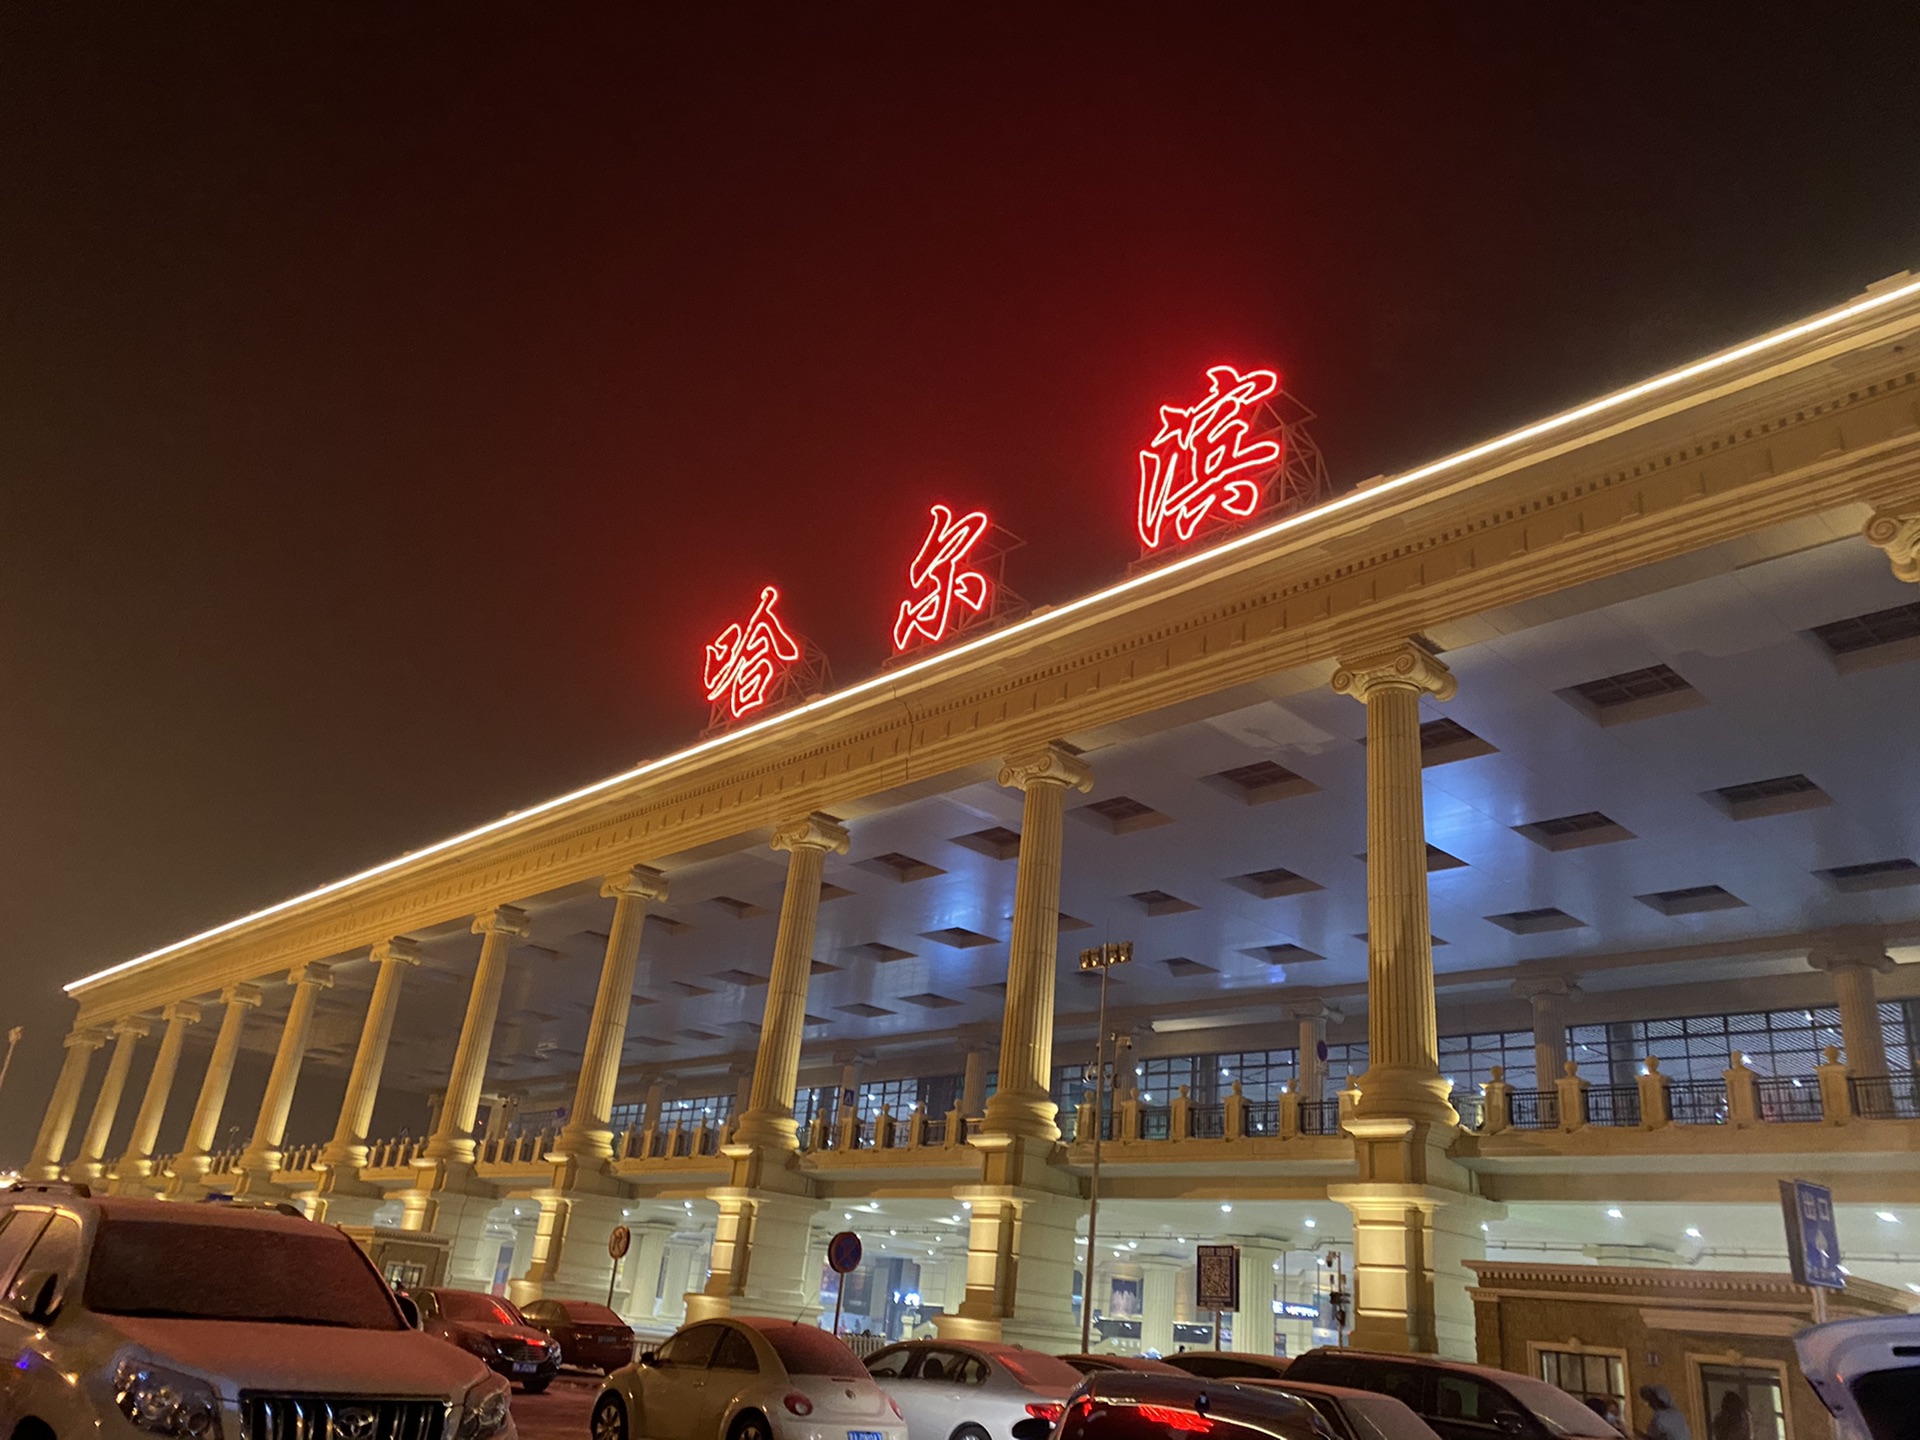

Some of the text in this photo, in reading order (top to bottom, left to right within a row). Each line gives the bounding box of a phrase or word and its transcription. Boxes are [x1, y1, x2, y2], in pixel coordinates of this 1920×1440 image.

[703, 365, 1280, 718] 哈尔滨
[1802, 1191, 1830, 1221] 出口
